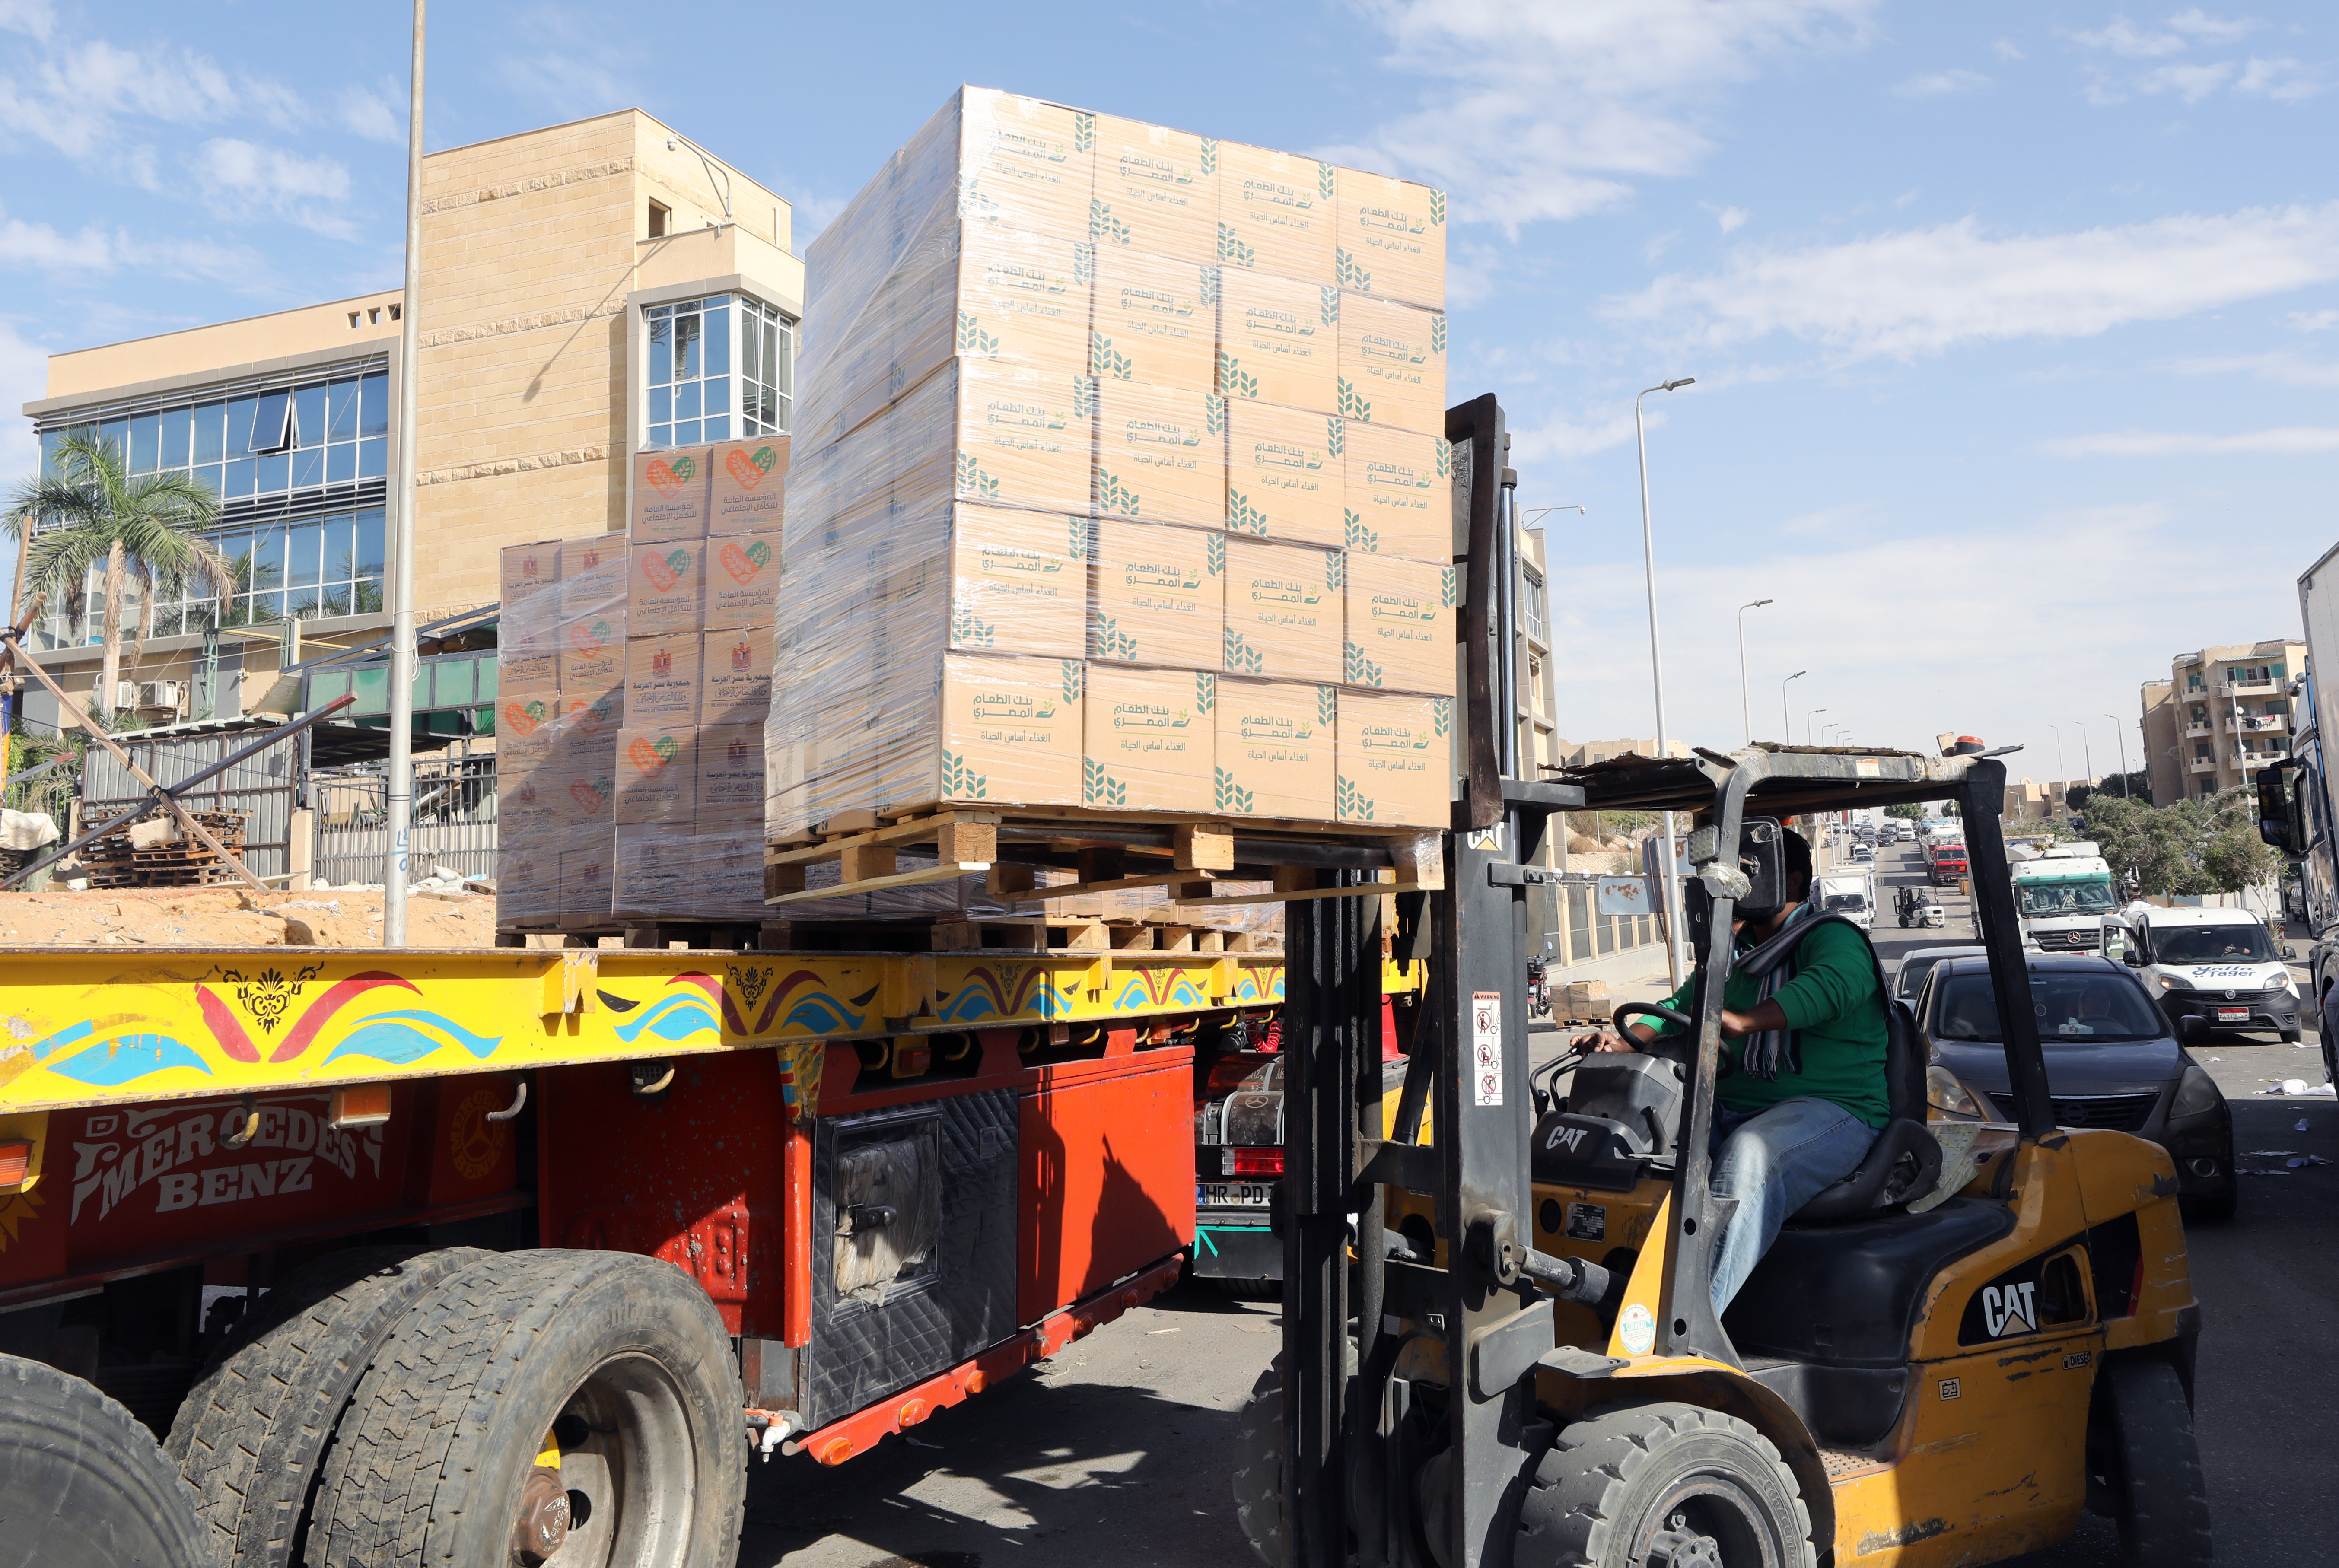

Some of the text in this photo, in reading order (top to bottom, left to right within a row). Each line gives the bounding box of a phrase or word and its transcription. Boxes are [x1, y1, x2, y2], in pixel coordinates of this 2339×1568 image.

[1243, 179, 1294, 198] بنك الطعام
[1243, 191, 1294, 207] المصري
[1249, 211, 1308, 229] الغذاء أساس الحياة
[1359, 206, 1407, 224] بنك الطعام
[1360, 217, 1407, 232] المصري
[1365, 236, 1421, 254] الغذاء أساس الحياة
[1246, 307, 1296, 325] بنك الطعام
[1246, 319, 1297, 334] المصري
[1252, 340, 1311, 357] الغذاء أساس الحياة
[1361, 334, 1409, 353] بنك الطعام
[1361, 345, 1408, 361] المصري
[1366, 366, 1421, 385] الغذاء أساس الحياة
[1254, 442, 1304, 459] بنك الطعام
[1255, 454, 1305, 468] المصري
[1366, 462, 1414, 478] بنك الطعام
[1261, 475, 1319, 491] الغذاء أساس الحياة
[1367, 474, 1414, 487] المصري
[745, 493, 776, 502] المؤسسة
[1373, 494, 1427, 509] الغذاء أساس الحياة
[665, 503, 694, 511] المؤسسة
[754, 502, 777, 511] للتكافل
[674, 511, 697, 520] للتكافل
[1125, 561, 1181, 578] بنك الطعام
[1126, 575, 1181, 588] المصري
[1251, 578, 1302, 594] بنك الطعام
[660, 596, 689, 604] المؤسسة
[740, 588, 771, 598] المؤسسة
[1251, 591, 1302, 603] المصري
[668, 605, 691, 614] للتكافل
[749, 597, 773, 607] للتكافل
[1132, 597, 1196, 612] الغذاء أساس الحياة
[1371, 594, 1419, 610] بنك الطعام
[1258, 612, 1316, 627] الغذاء أساس الحياة
[1372, 607, 1419, 619] المصري
[1377, 627, 1432, 642] الغذاء أساس الحياة
[588, 659, 612, 668] المؤسسة
[596, 667, 614, 675] للتكافل
[667, 681, 690, 689] جمهورية
[711, 675, 730, 685] العربية
[746, 674, 770, 683] جمهورية
[633, 682, 651, 691] العربية
[973, 693, 1033, 708] بنك الطعام
[973, 707, 1033, 720] المصري
[1114, 703, 1169, 718] بنك الطعام
[1114, 717, 1169, 729] المصري
[1241, 714, 1293, 729] بنك الطعام
[980, 729, 1050, 744] الغذاء أساس الحياة
[1241, 728, 1293, 740] المصري
[1362, 725, 1411, 740] بنك الطعام
[1121, 738, 1185, 752] الغذاء أساس الحياة
[1362, 738, 1411, 750] المصري
[1247, 749, 1308, 763] الغذاء أساس الحياة
[1368, 759, 1425, 772] الغذاء أساس الحياة
[2192, 966, 2254, 977] Yalla
[1546, 1126, 1588, 1153] CAT
[453, 1148, 501, 1179] BENZ
[156, 1156, 314, 1213] BENZ
[1206, 1186, 1228, 1204] HR
[1241, 1186, 1263, 1204] PD
[1983, 1281, 2036, 1337] CAT
[1626, 1321, 1647, 1332] CERTIFICATE
[2070, 1352, 2091, 1366] DIESEL
